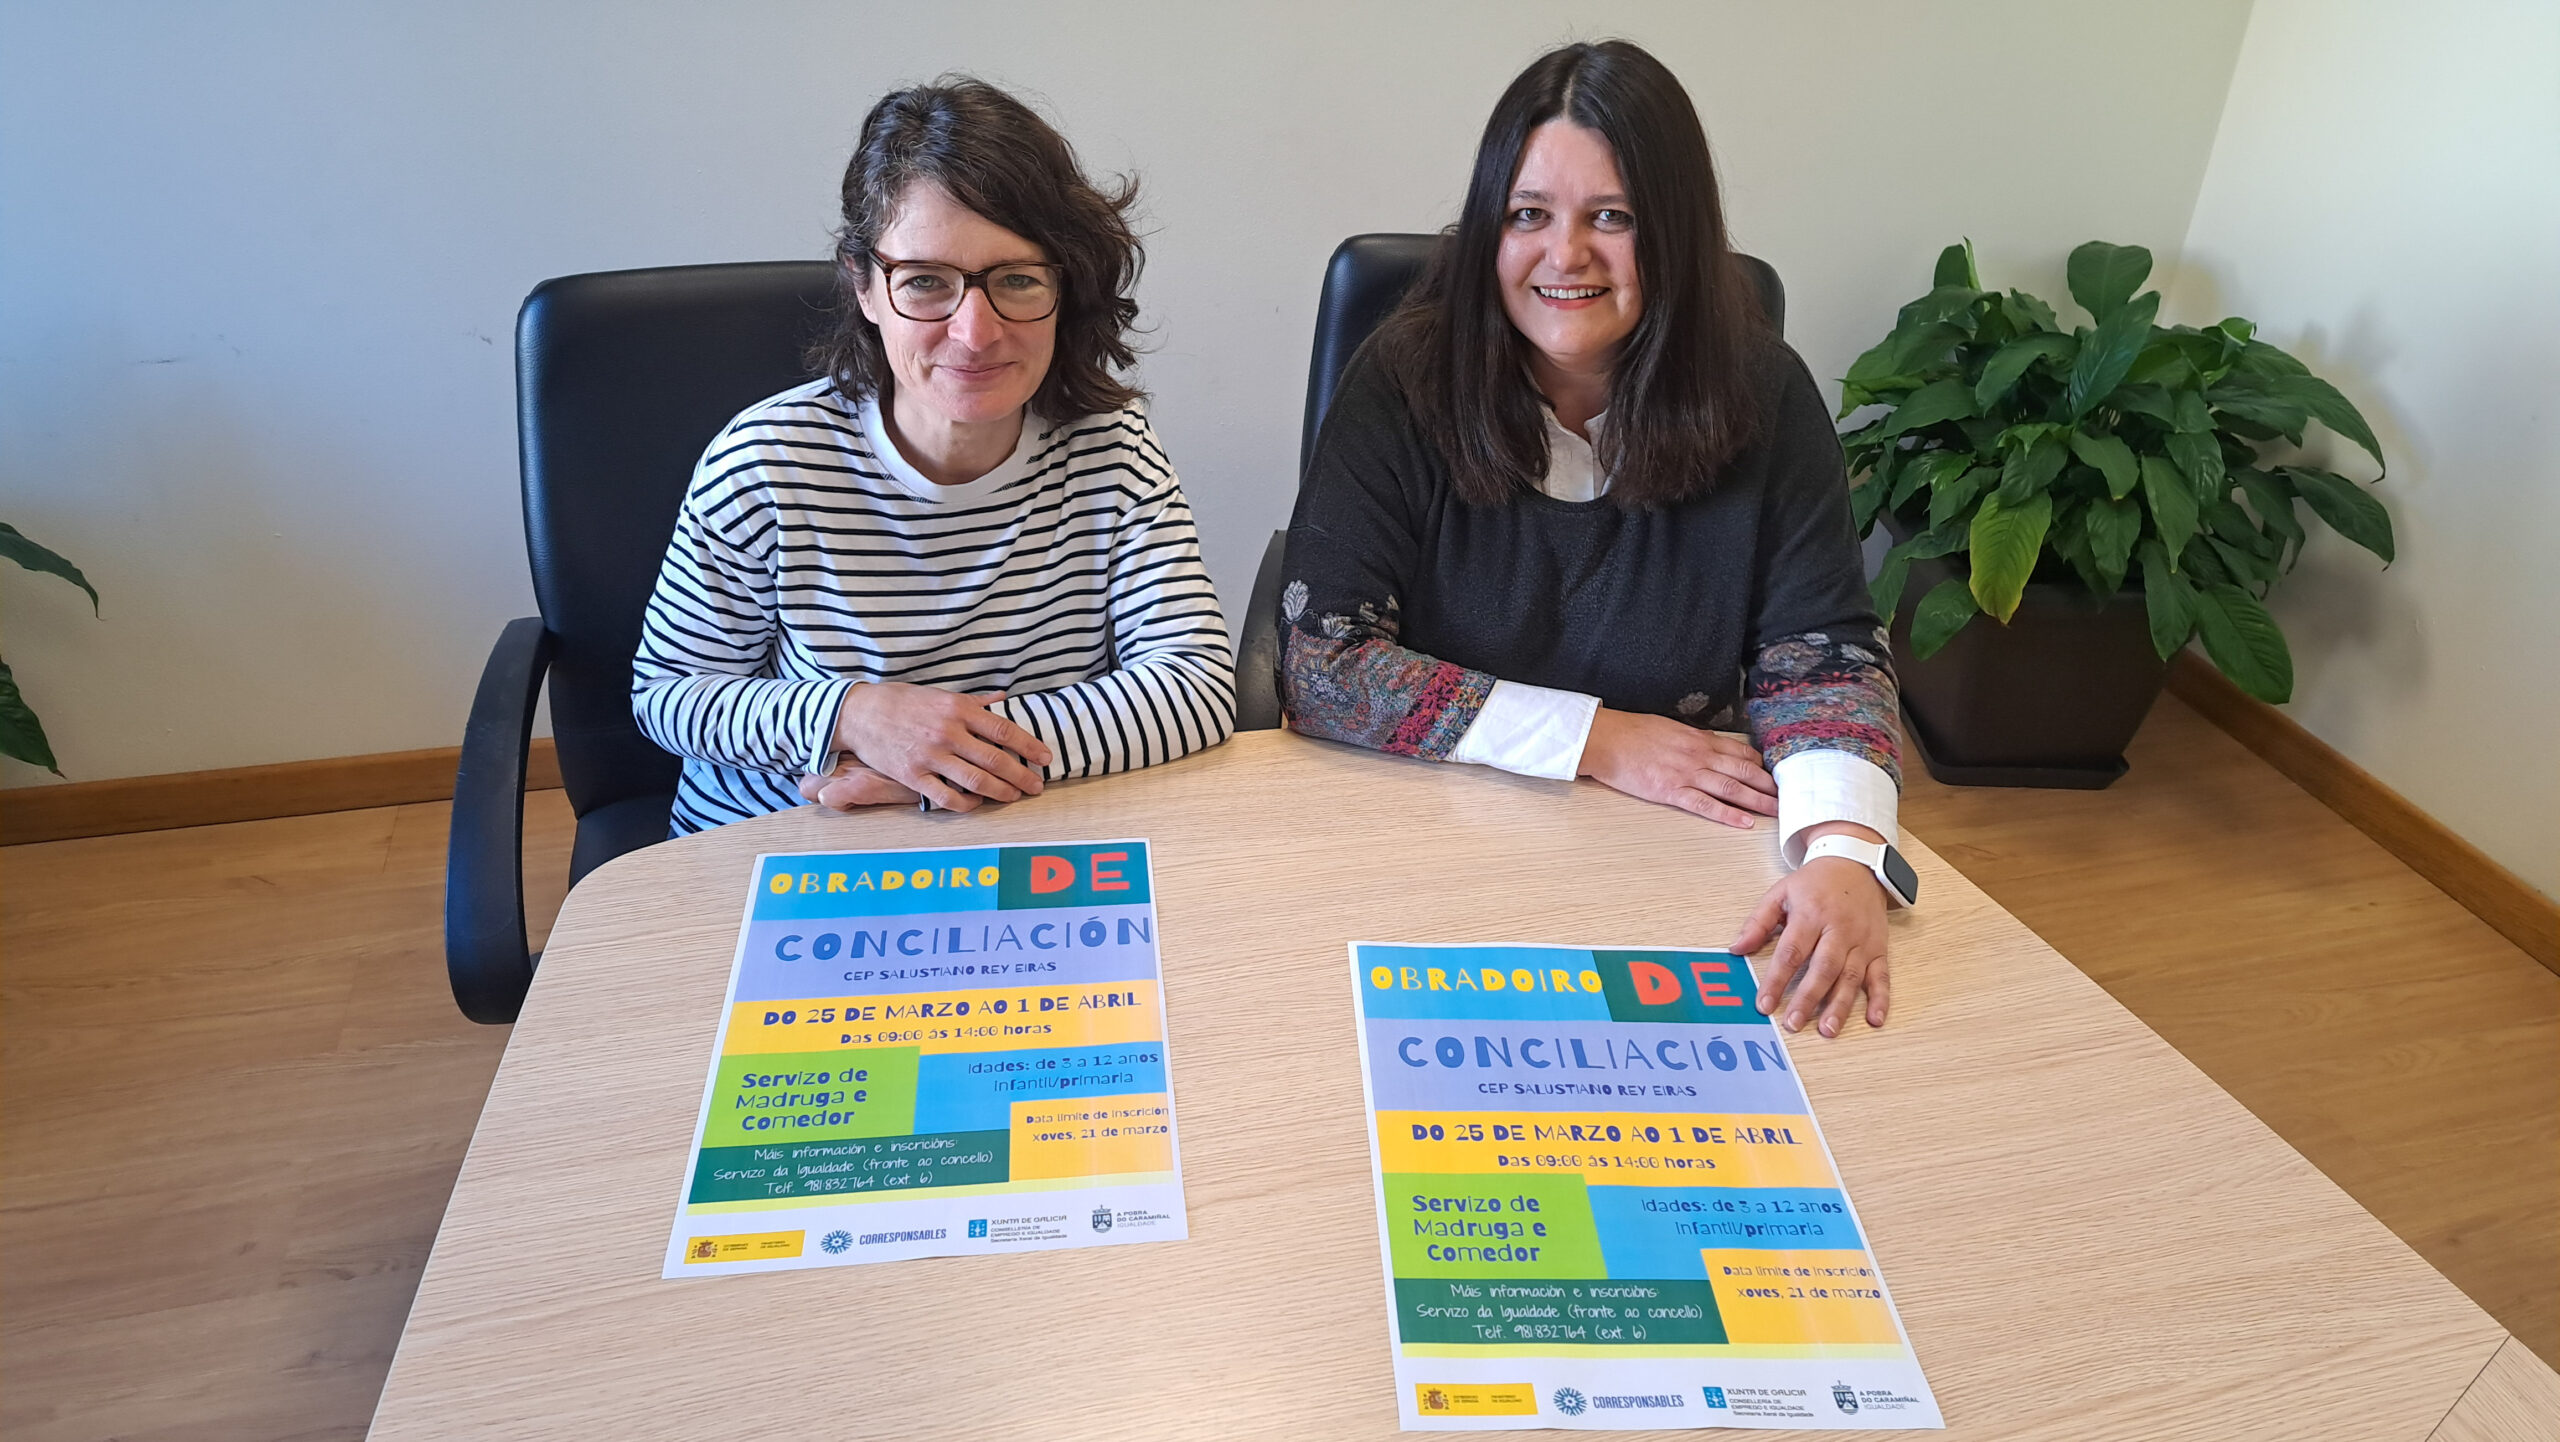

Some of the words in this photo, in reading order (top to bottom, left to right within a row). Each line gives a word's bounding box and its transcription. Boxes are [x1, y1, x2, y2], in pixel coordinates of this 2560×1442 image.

[769, 866, 1000, 895] OBRADOIRO
[1030, 851, 1130, 894] DE
[774, 915, 1151, 962] CONCILIACIÓN
[843, 970, 874, 982] CEP
[879, 965, 975, 980] SALUSTIANO
[981, 964, 1009, 975] REY
[1015, 961, 1057, 973] EIRAS
[1370, 965, 1603, 993] OBRADOIRO
[1627, 961, 1743, 1006] DE
[763, 1010, 797, 1026] DO
[805, 1008, 835, 1024] 25
[845, 1006, 875, 1022] DE
[886, 1001, 970, 1020] MARZO
[979, 999, 1008, 1015] AO
[1017, 998, 1030, 1013] 1
[1040, 997, 1069, 1011] DE
[1078, 991, 1142, 1010] ABRIL
[841, 1032, 872, 1044] Das
[878, 1029, 923, 1042] 09:00
[954, 1025, 999, 1038] 14:00
[1003, 1022, 1052, 1036] horas
[968, 1061, 1029, 1074] Idades:
[1035, 1058, 1056, 1070] de
[1077, 1058, 1087, 1068] a
[1094, 1055, 1113, 1066] 12
[1118, 1053, 1159, 1064] anos
[1398, 1036, 1789, 1072] CONCILIACIÓN
[741, 1071, 830, 1088] Servizo
[839, 1068, 868, 1083] de
[735, 1090, 844, 1109] Madruga
[854, 1089, 867, 1102] e
[1479, 1083, 1507, 1094] CEP
[1514, 1083, 1612, 1095] SALUSTIANO
[1618, 1085, 1646, 1096] REY
[1652, 1085, 1697, 1097] EIRAS
[742, 1110, 855, 1130] Comedor
[1093, 1109, 1108, 1120] de
[1081, 1128, 1096, 1139] 21
[1101, 1126, 1118, 1137] de
[1123, 1125, 1168, 1136] marzo
[1412, 1124, 1444, 1141] DO
[1455, 1124, 1484, 1141] 25
[1493, 1125, 1526, 1141] DE
[1535, 1125, 1621, 1142] MARZO
[1631, 1126, 1660, 1143] AO
[1669, 1127, 1684, 1143] 1
[1694, 1127, 1726, 1143] DE
[1734, 1127, 1802, 1145] ABRIL
[754, 1147, 784, 1161] Máis
[792, 1142, 866, 1159] información
[875, 1144, 882, 1152] e
[714, 1168, 765, 1181] Servizo
[773, 1166, 788, 1177] da
[797, 1161, 854, 1178] Igualdade
[863, 1158, 909, 1172] (fronte
[918, 1158, 932, 1167] ao
[941, 1151, 993, 1165] concello)
[1498, 1155, 1530, 1167] Das
[1535, 1154, 1582, 1167] 09:00
[1613, 1156, 1659, 1169] 14:00
[1664, 1156, 1716, 1169] horas
[764, 1182, 794, 1195] Telf.
[1412, 1195, 1501, 1212] Servizo
[1510, 1195, 1540, 1212] de
[1641, 1199, 1706, 1213] Idades:
[1712, 1200, 1735, 1212] de
[1756, 1202, 1767, 1213] a
[1773, 1201, 1794, 1213] 12
[1800, 1201, 1842, 1213] anos
[859, 1229, 946, 1245] CORRESPONSABLES
[1413, 1219, 1524, 1240] Madruga
[1532, 1222, 1547, 1237] e
[1427, 1243, 1540, 1262] Comedor
[1794, 1266, 1811, 1276] de
[1489, 1284, 1566, 1298] información
[1573, 1289, 1582, 1297] e
[1787, 1287, 1804, 1298] 21
[1810, 1287, 1829, 1298] de
[1832, 1288, 1881, 1298] marzo
[1416, 1304, 1468, 1318] Servizo
[1477, 1305, 1493, 1318] da
[1500, 1305, 1560, 1322] Igualdade
[1568, 1304, 1616, 1320] (fronte
[1625, 1308, 1640, 1318] ao
[1648, 1304, 1703, 1320] concello)
[1472, 1325, 1506, 1339] Telf.
[1727, 1388, 1757, 1396] XUNTA
[1592, 1395, 1684, 1409] CORRESPONSABLES
